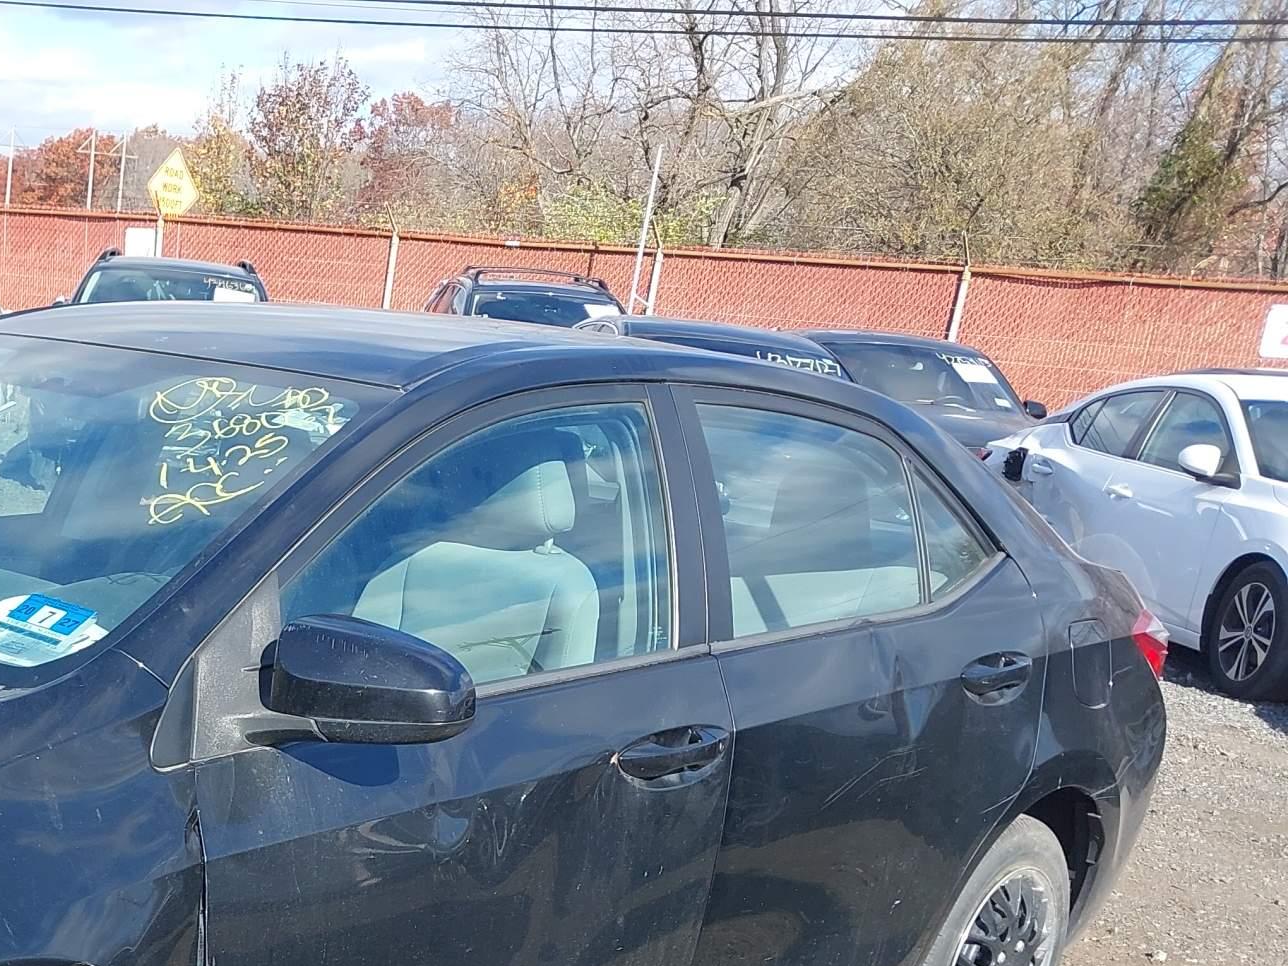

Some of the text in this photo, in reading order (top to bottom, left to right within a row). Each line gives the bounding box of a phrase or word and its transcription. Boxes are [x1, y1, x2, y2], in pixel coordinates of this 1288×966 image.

[17, 604, 36, 616] 20
[39, 611, 56, 625] 7
[58, 616, 80, 629] 27
